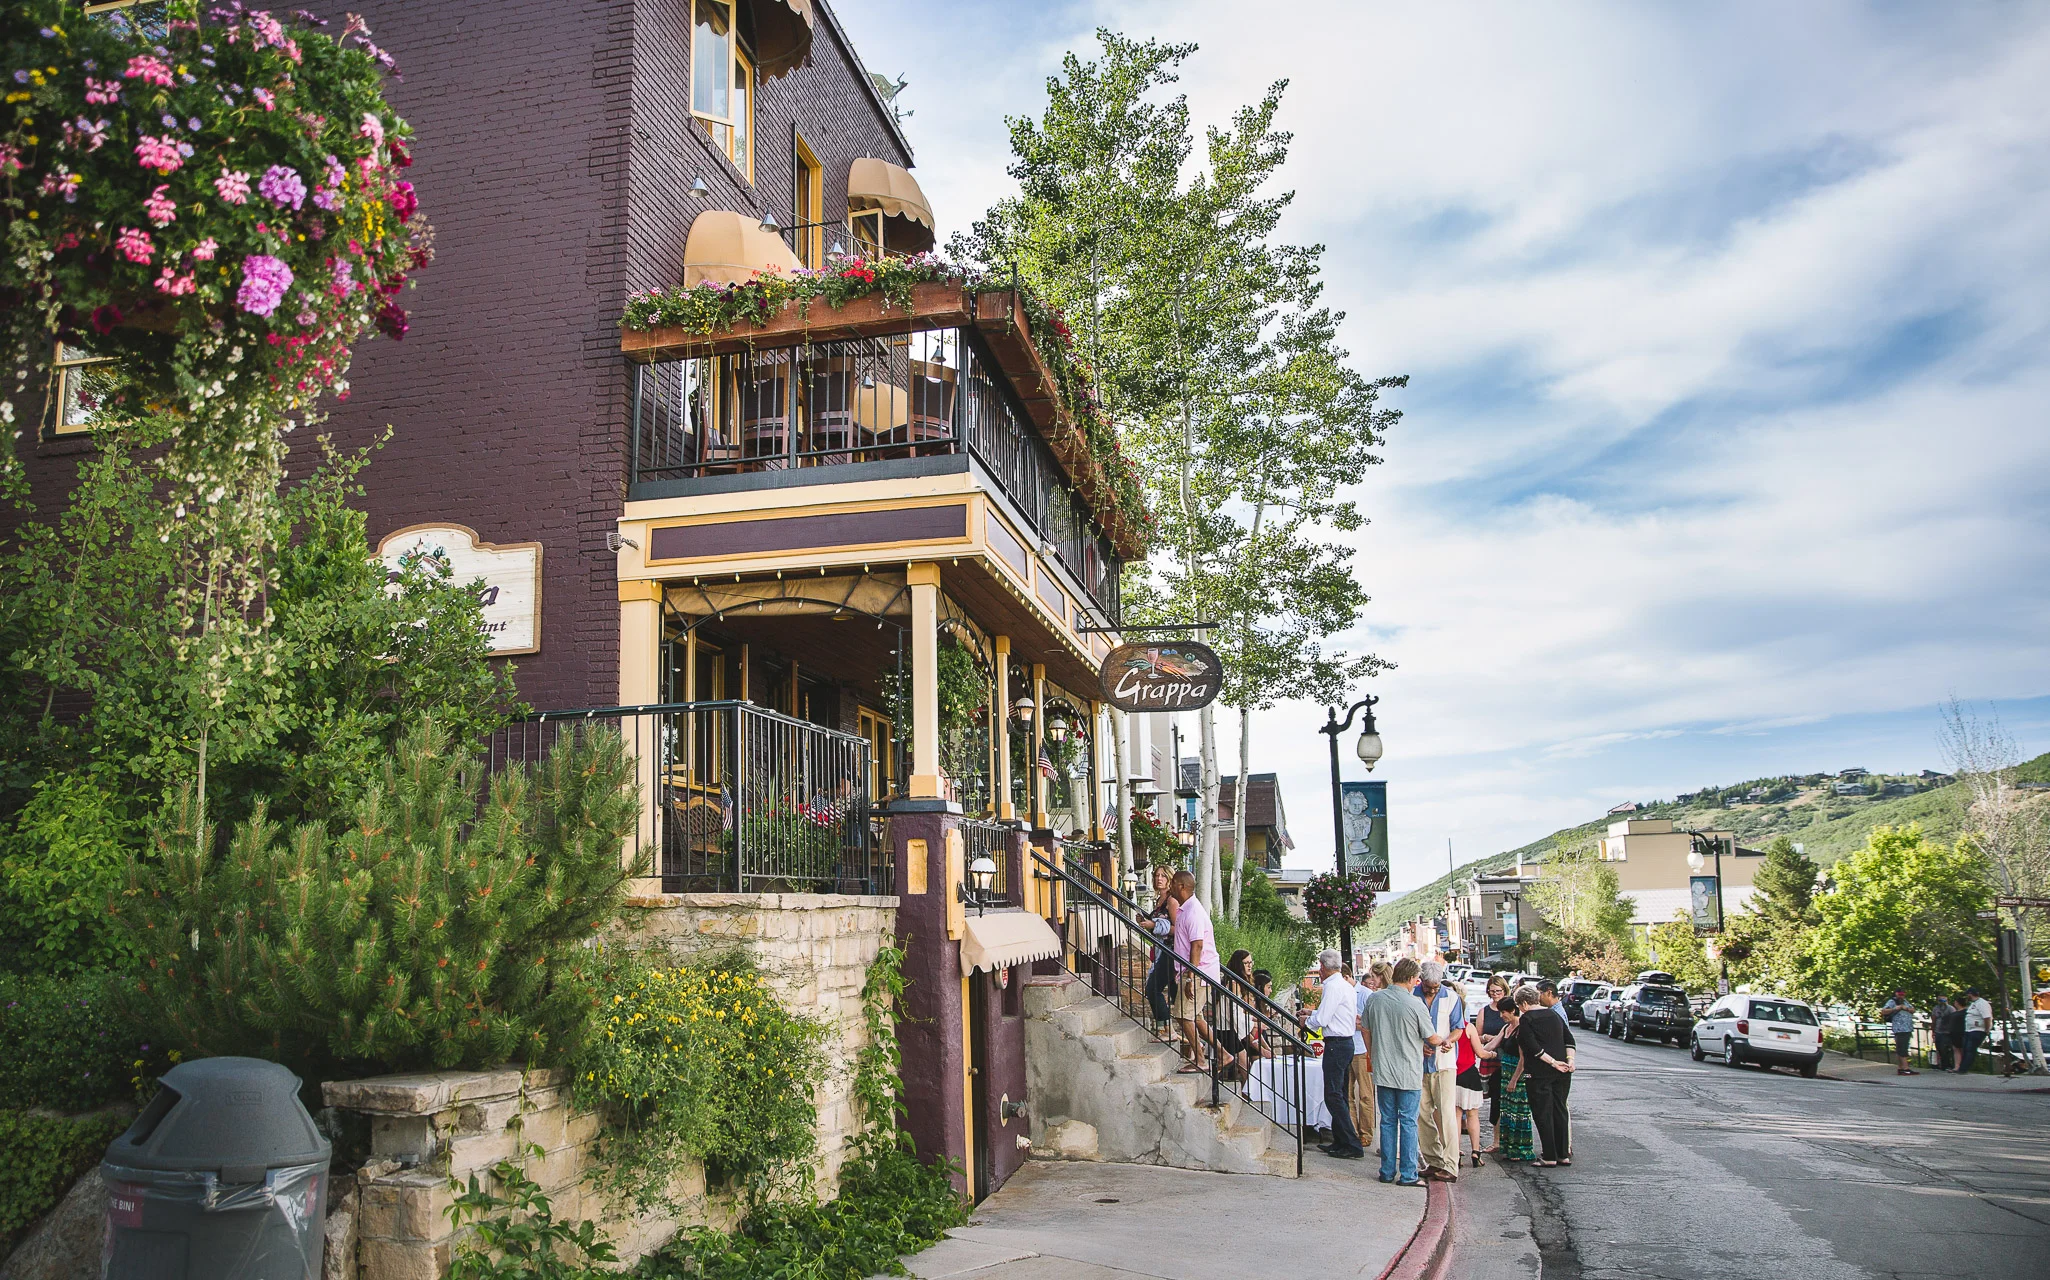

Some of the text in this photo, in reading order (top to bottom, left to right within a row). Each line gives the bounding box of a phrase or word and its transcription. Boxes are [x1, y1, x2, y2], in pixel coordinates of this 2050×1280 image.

[907, 109, 915, 117] W
[1114, 667, 1207, 706] Grappa
[118, 1199, 135, 1212] BIN!
